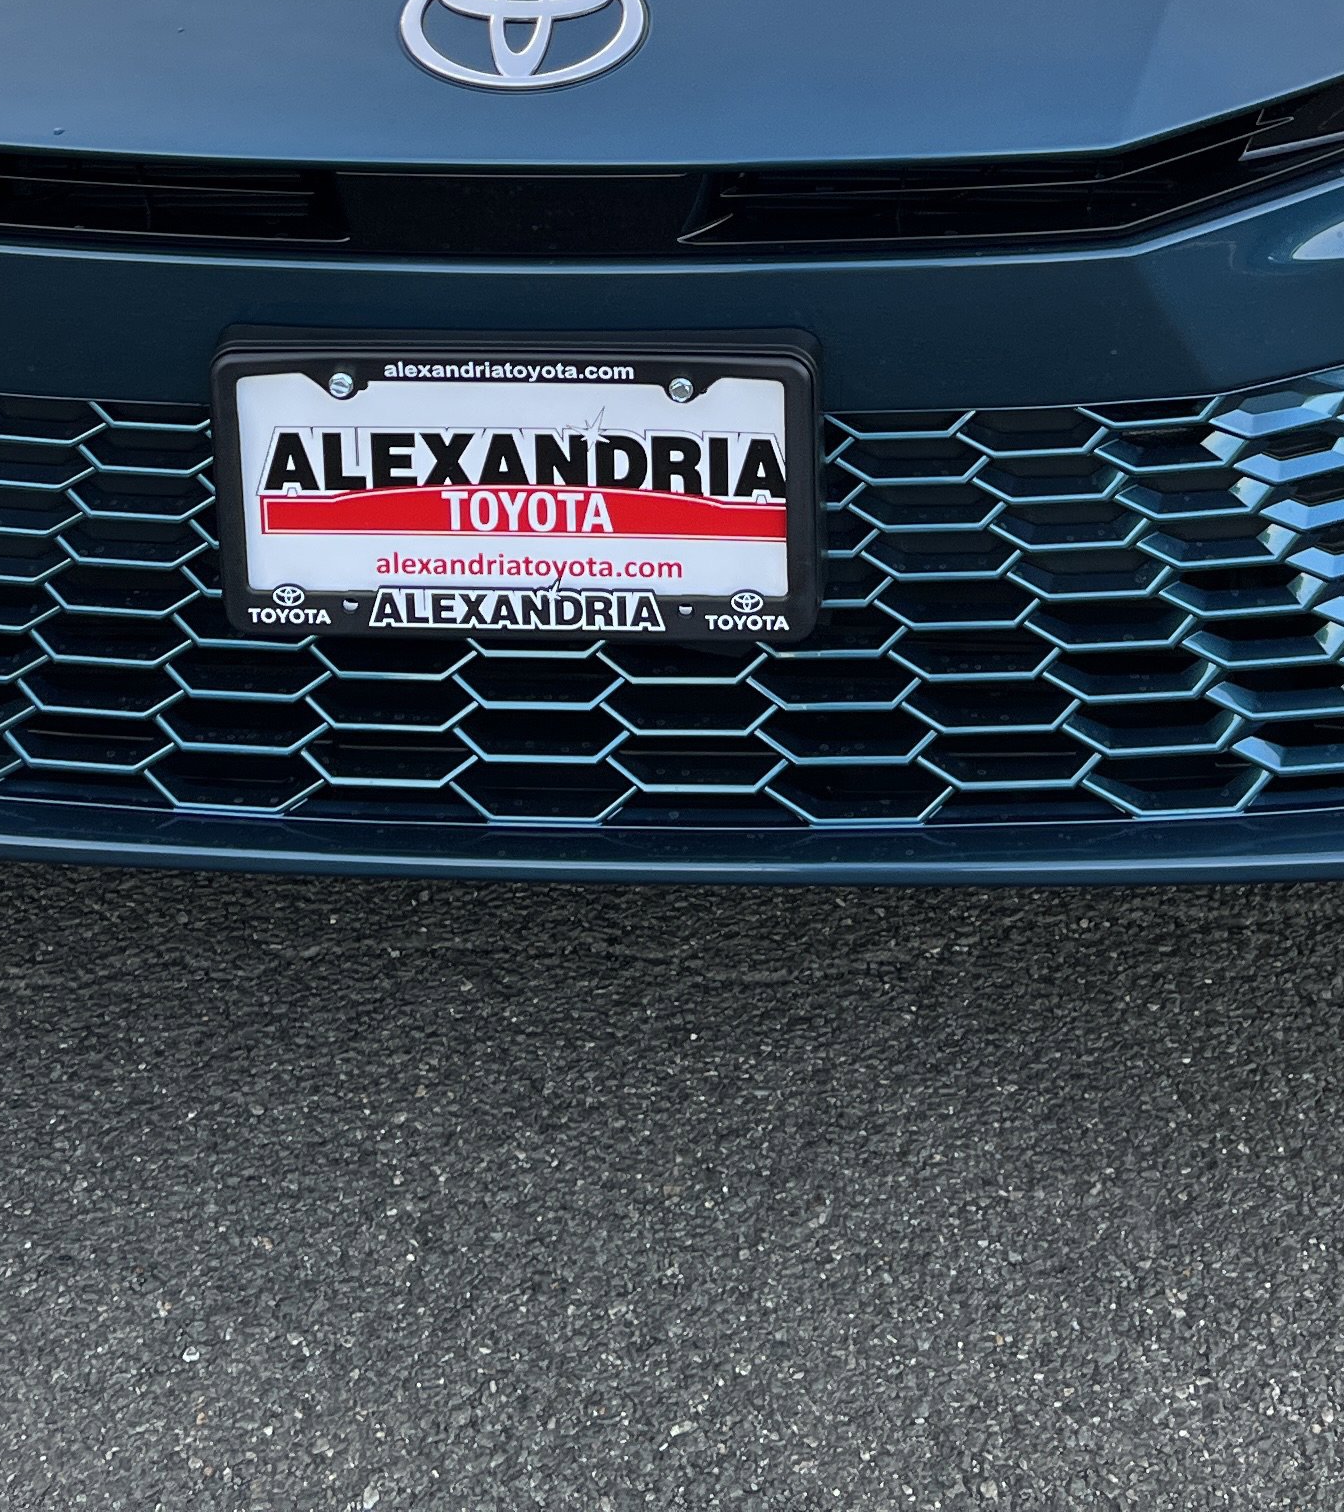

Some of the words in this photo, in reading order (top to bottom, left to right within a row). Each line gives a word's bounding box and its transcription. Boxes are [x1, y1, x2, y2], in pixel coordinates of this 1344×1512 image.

[383, 360, 635, 383] alexandriatoyota.com
[263, 431, 787, 497] ALEXANDRIA
[441, 491, 614, 533] TOYOTA
[376, 551, 683, 581] alexandriatoyota.com
[247, 607, 332, 625] TOYOTA
[370, 590, 665, 632] ALEXANDRIA
[705, 614, 790, 631] TOYOTA
